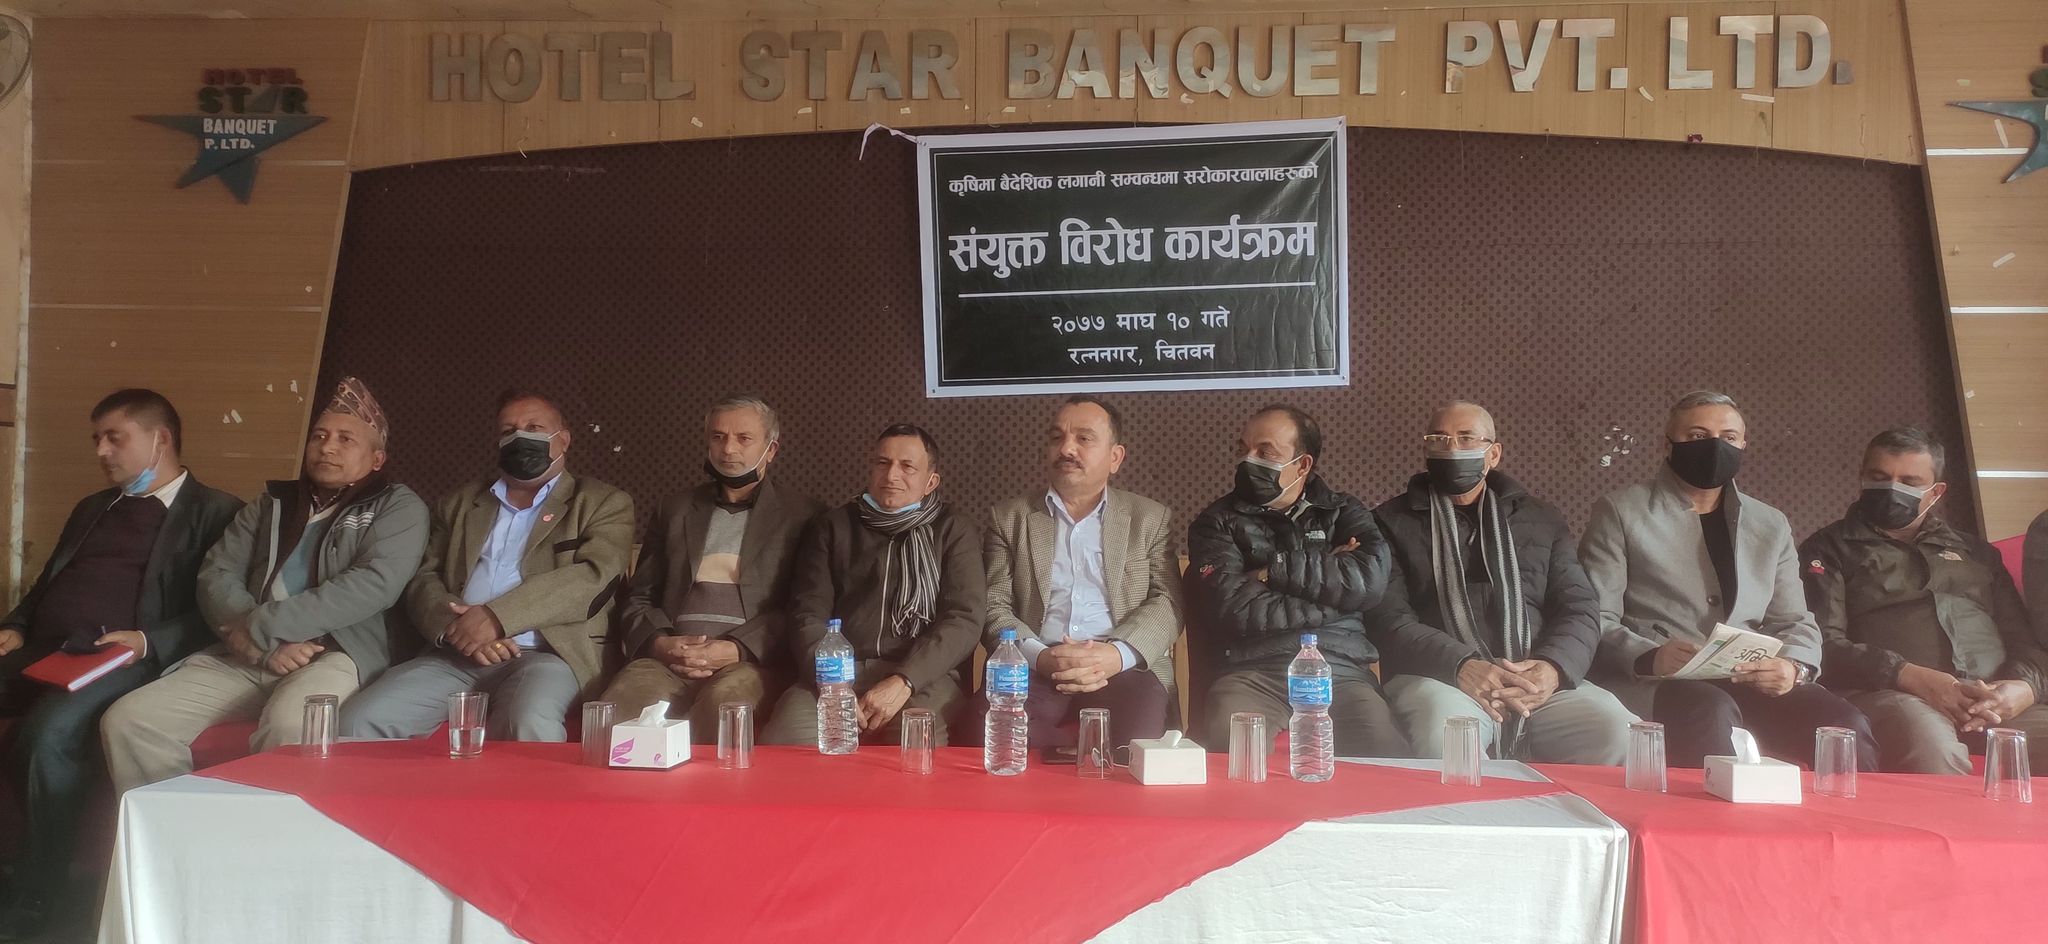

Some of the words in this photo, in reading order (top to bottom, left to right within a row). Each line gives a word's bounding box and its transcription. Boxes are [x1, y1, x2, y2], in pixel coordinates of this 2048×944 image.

[428, 30, 696, 103] HOTEL
[739, 28, 961, 102] STAR
[1007, 23, 1396, 100] BANQUET
[1445, 18, 1629, 94] PVT.
[1668, 14, 1852, 90] LTD.
[203, 67, 304, 86] HOTEL
[203, 118, 278, 135] BANQUET
[948, 174, 996, 197] कृषिमा
[1000, 172, 1053, 191] बैदेशिक
[1057, 170, 1106, 190] लगानी
[948, 226, 1049, 279] संयुक्त
[1059, 217, 1154, 266] विरोध
[1164, 213, 1318, 262] कार्यक्रम
[1051, 315, 1106, 335] २०७७
[1116, 313, 1157, 331] माघ
[1167, 311, 1191, 331] १०
[1200, 305, 1231, 328] गते
[1067, 346, 1144, 366] रत्ननगर,
[1154, 339, 1216, 361] चितवन
